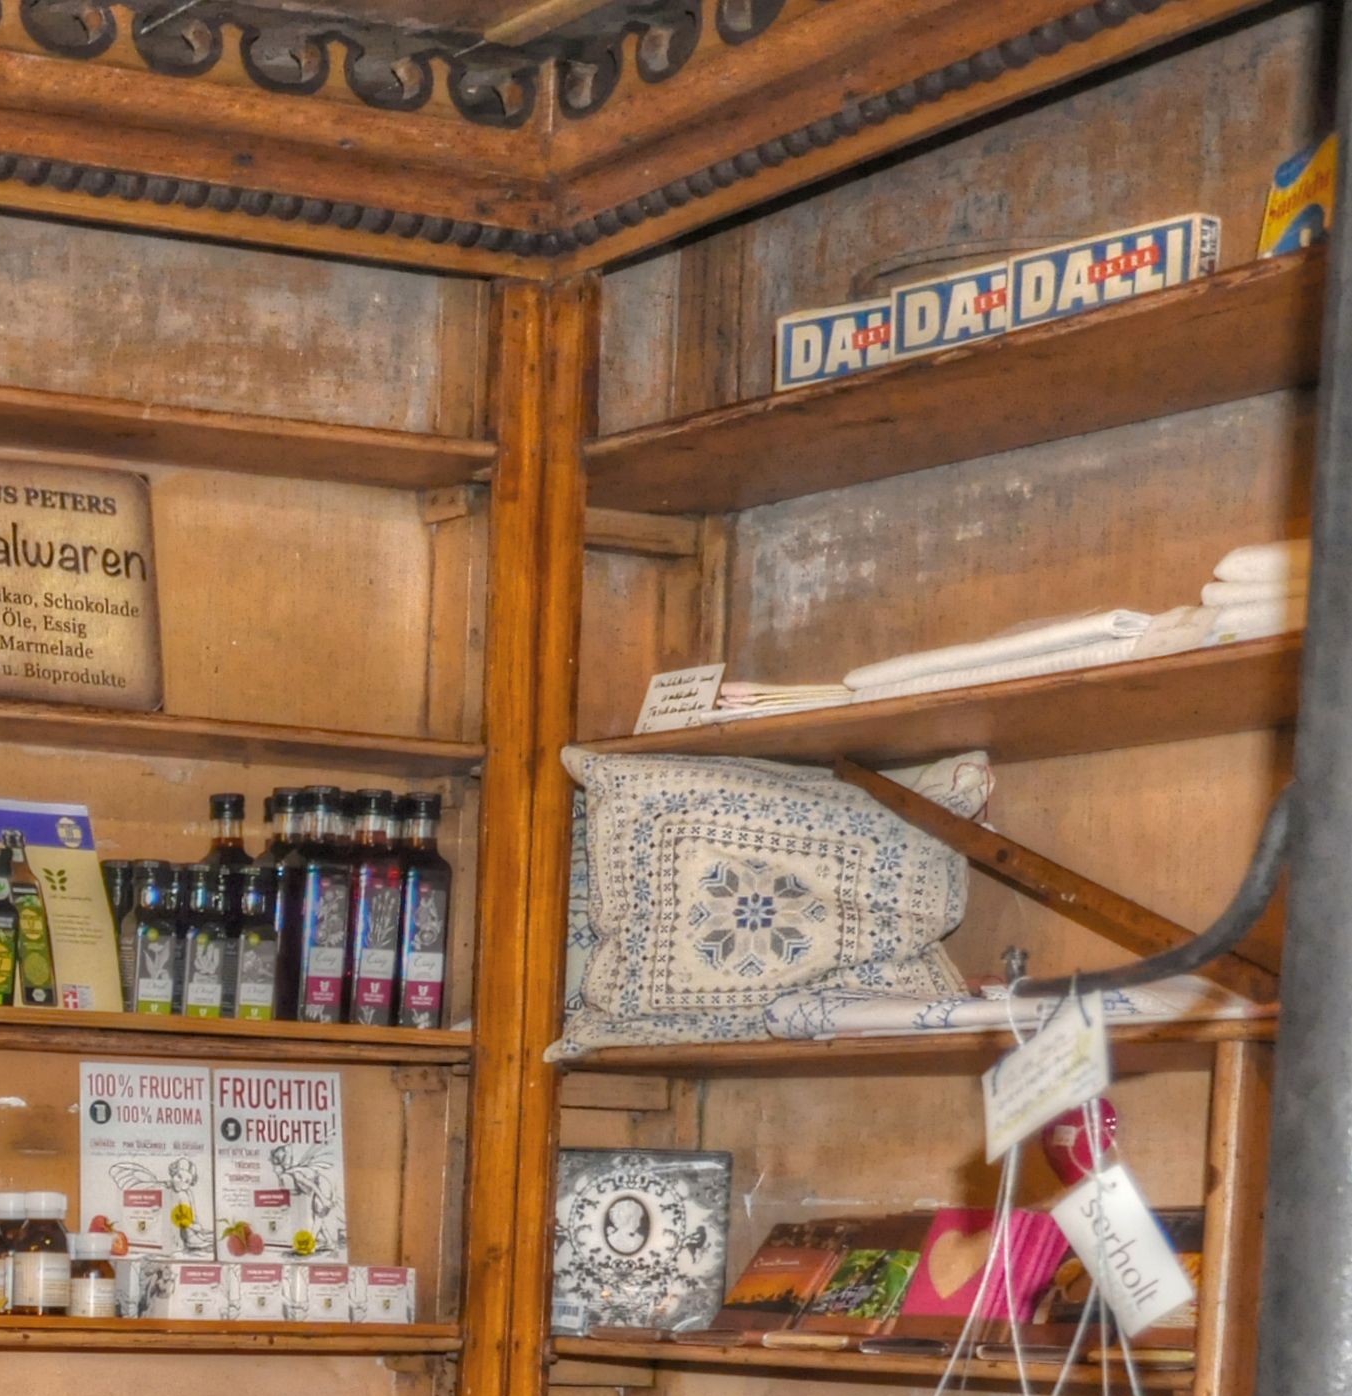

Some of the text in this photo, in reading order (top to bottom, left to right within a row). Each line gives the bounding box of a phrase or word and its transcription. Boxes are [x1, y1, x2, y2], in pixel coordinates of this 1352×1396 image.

[1019, 227, 1185, 320] DALLI
[1091, 248, 1156, 281] EXTRA
[977, 292, 1004, 311] EX
[856, 326, 889, 348] EXT
[22, 486, 117, 516] PETERS
[42, 592, 140, 618] Schokolade
[2, 608, 36, 632] Öle,
[42, 615, 88, 639] Essig
[2, 663, 18, 677] u.
[22, 661, 127, 690] Bioprodukte
[87, 1073, 205, 1100] 100% FRUCHT
[116, 1105, 203, 1126] 100% AROMA
